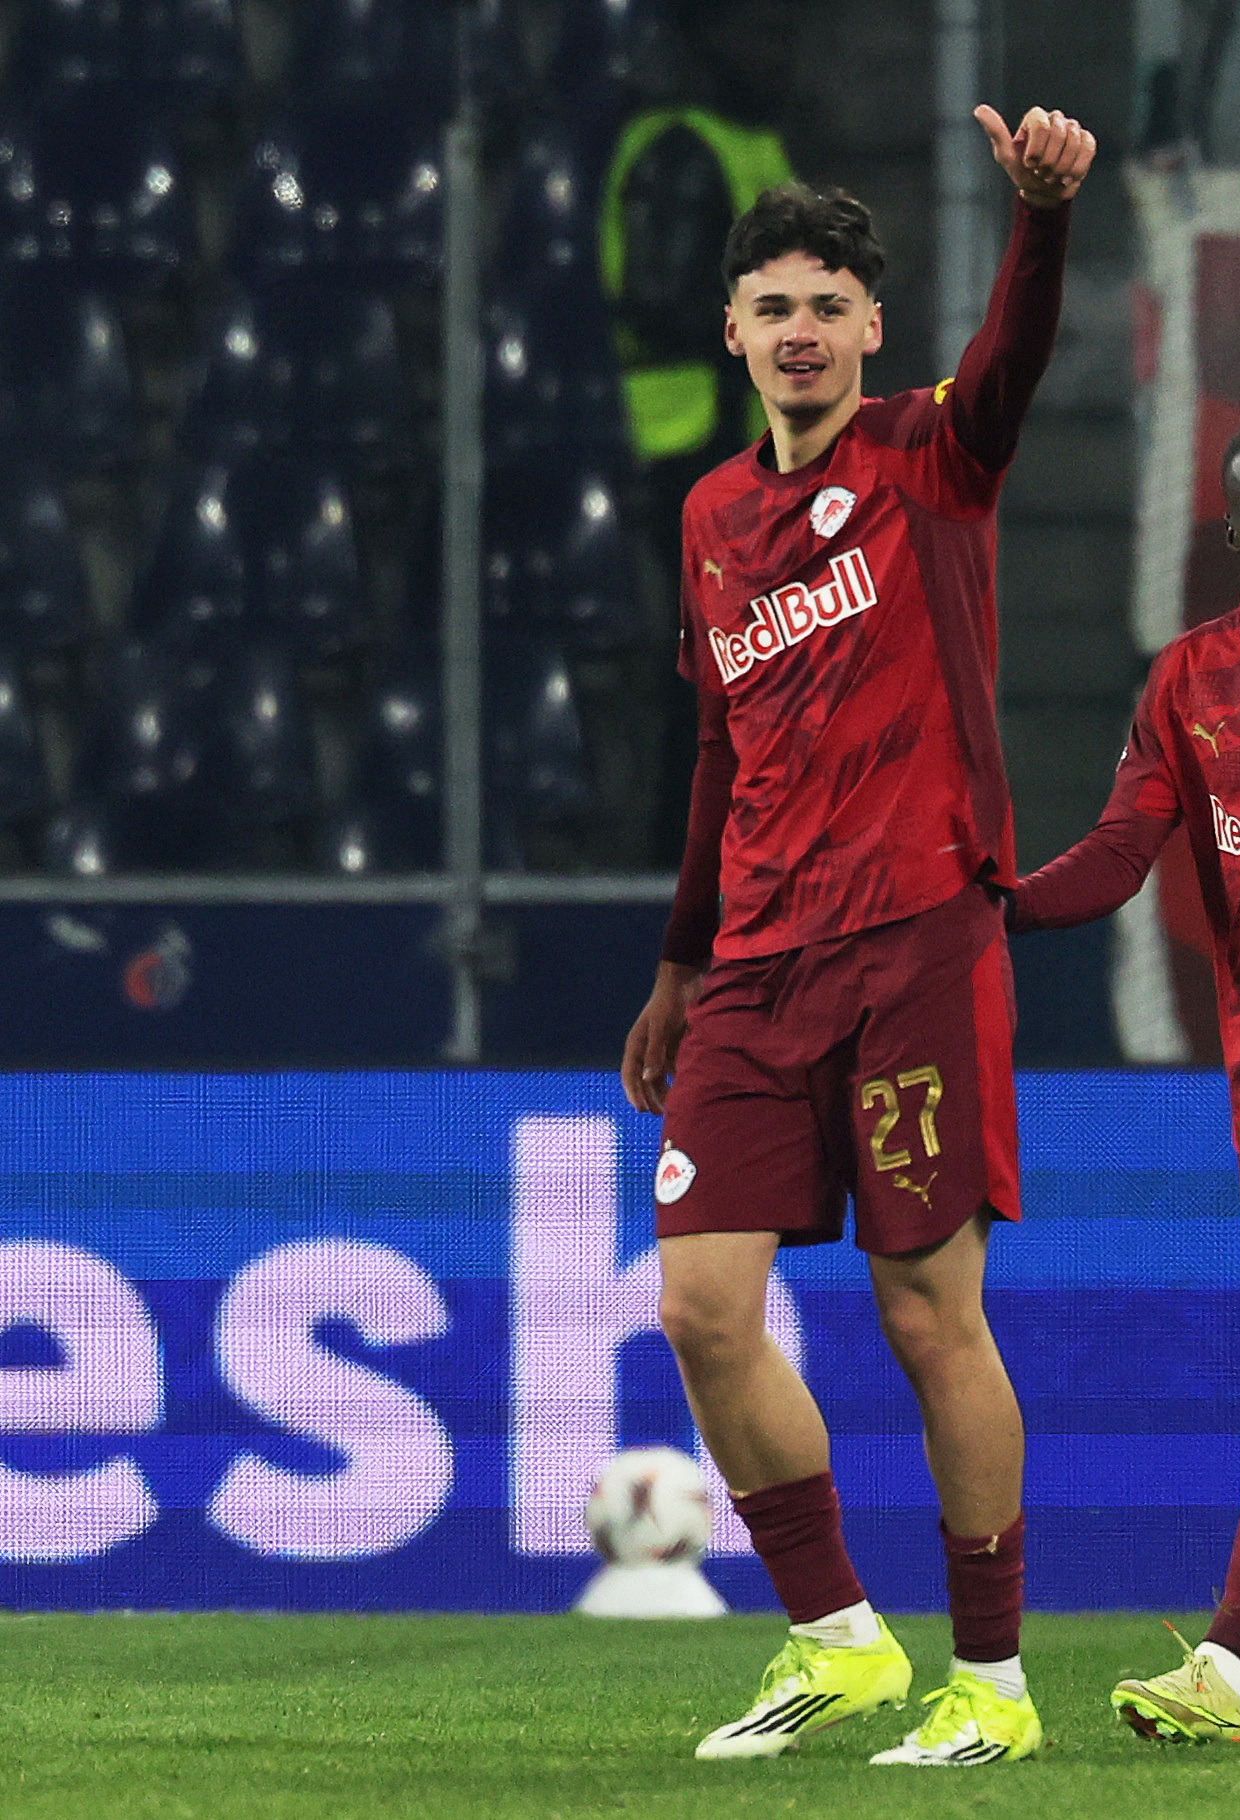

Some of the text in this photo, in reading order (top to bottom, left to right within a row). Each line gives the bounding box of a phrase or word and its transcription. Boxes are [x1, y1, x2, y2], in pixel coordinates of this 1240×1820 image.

[708, 546, 878, 685] Red Bull
[861, 1064, 944, 1172] 27
[0, 1112, 804, 1561] esh
